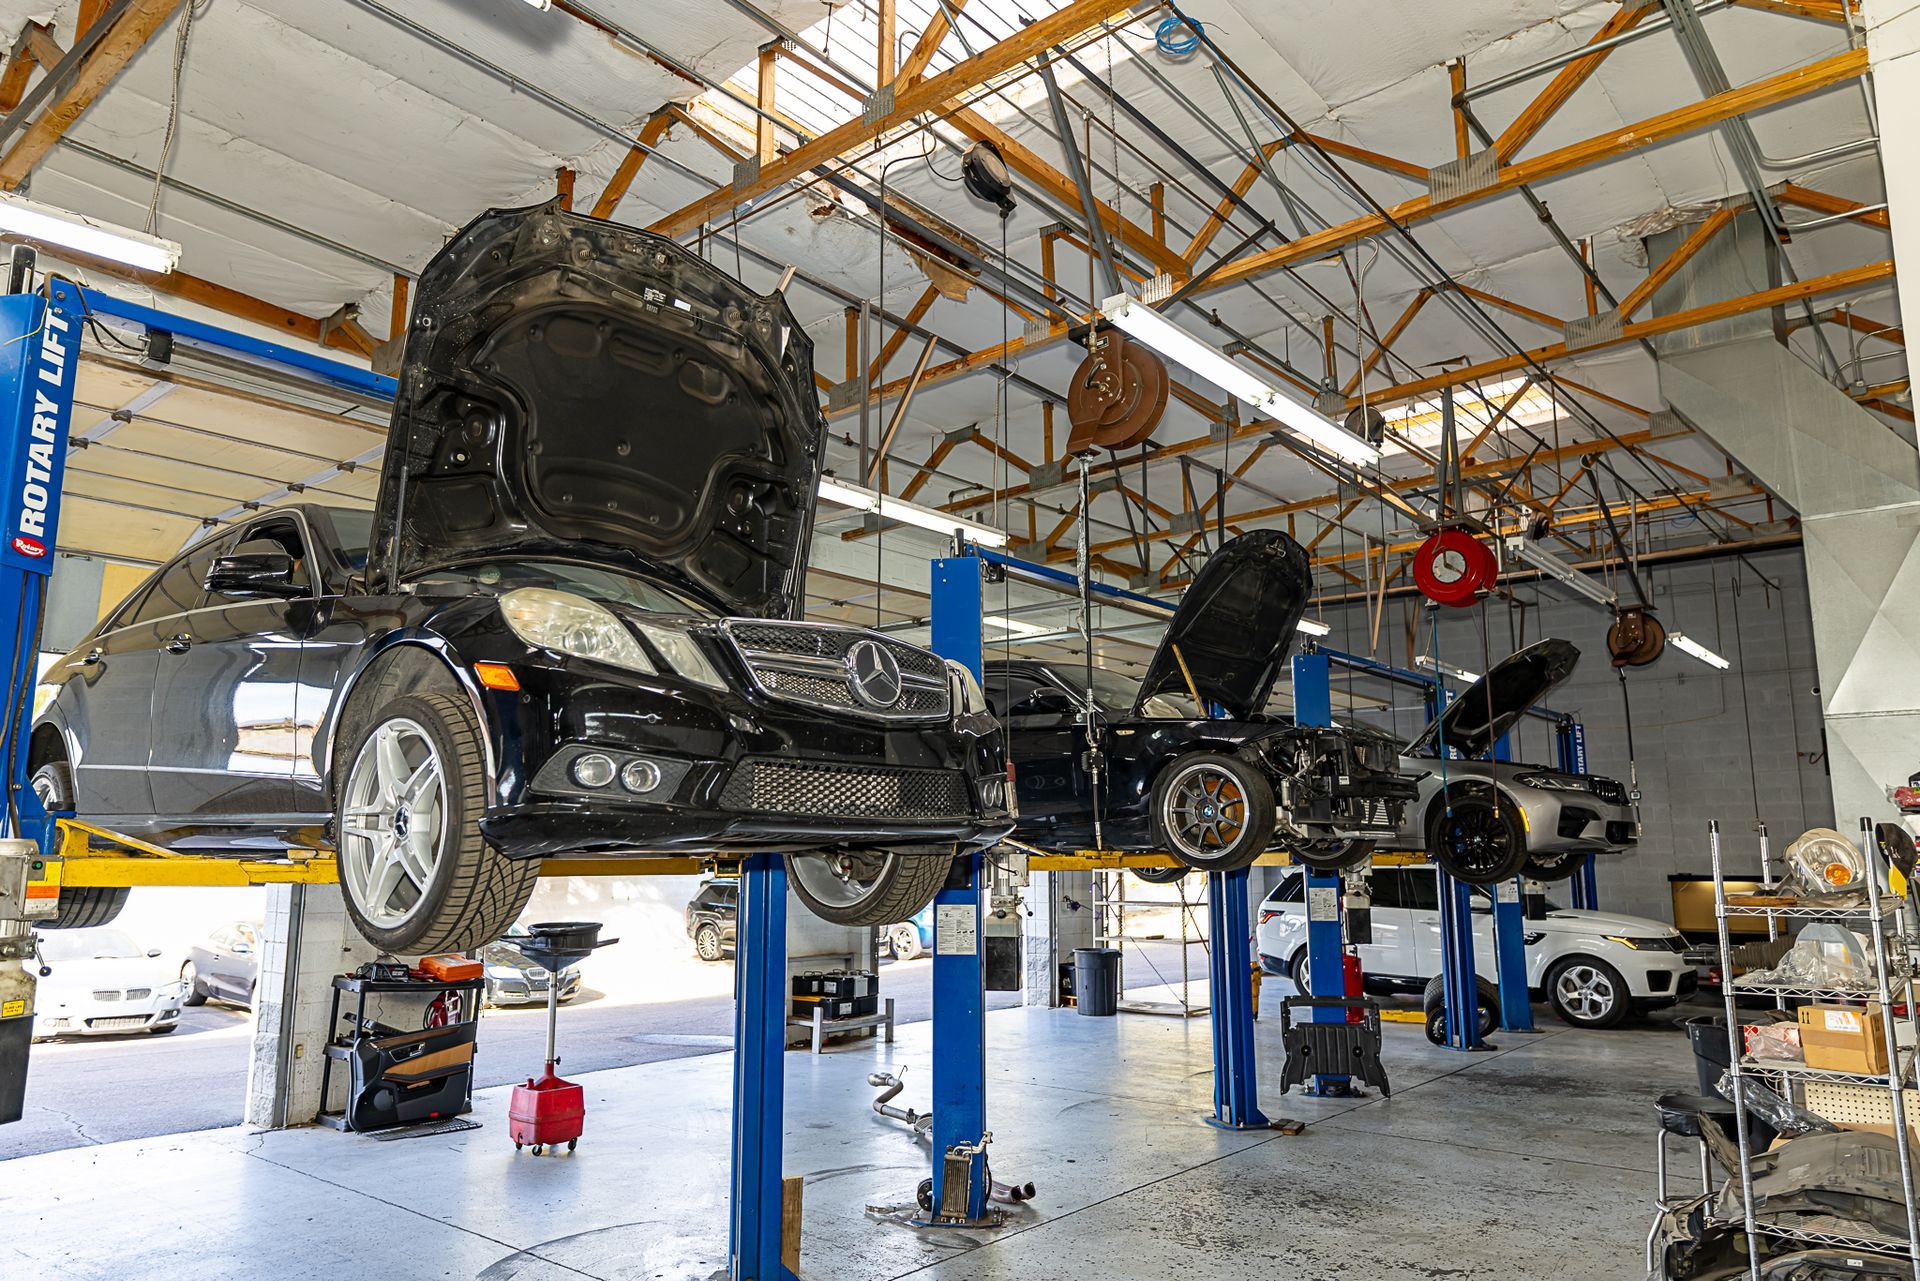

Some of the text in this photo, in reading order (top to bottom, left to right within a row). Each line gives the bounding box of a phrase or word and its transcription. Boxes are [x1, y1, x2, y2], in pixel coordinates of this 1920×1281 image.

[19, 307, 69, 538] ROTARY LIFT
[15, 537, 44, 554] Rotary
